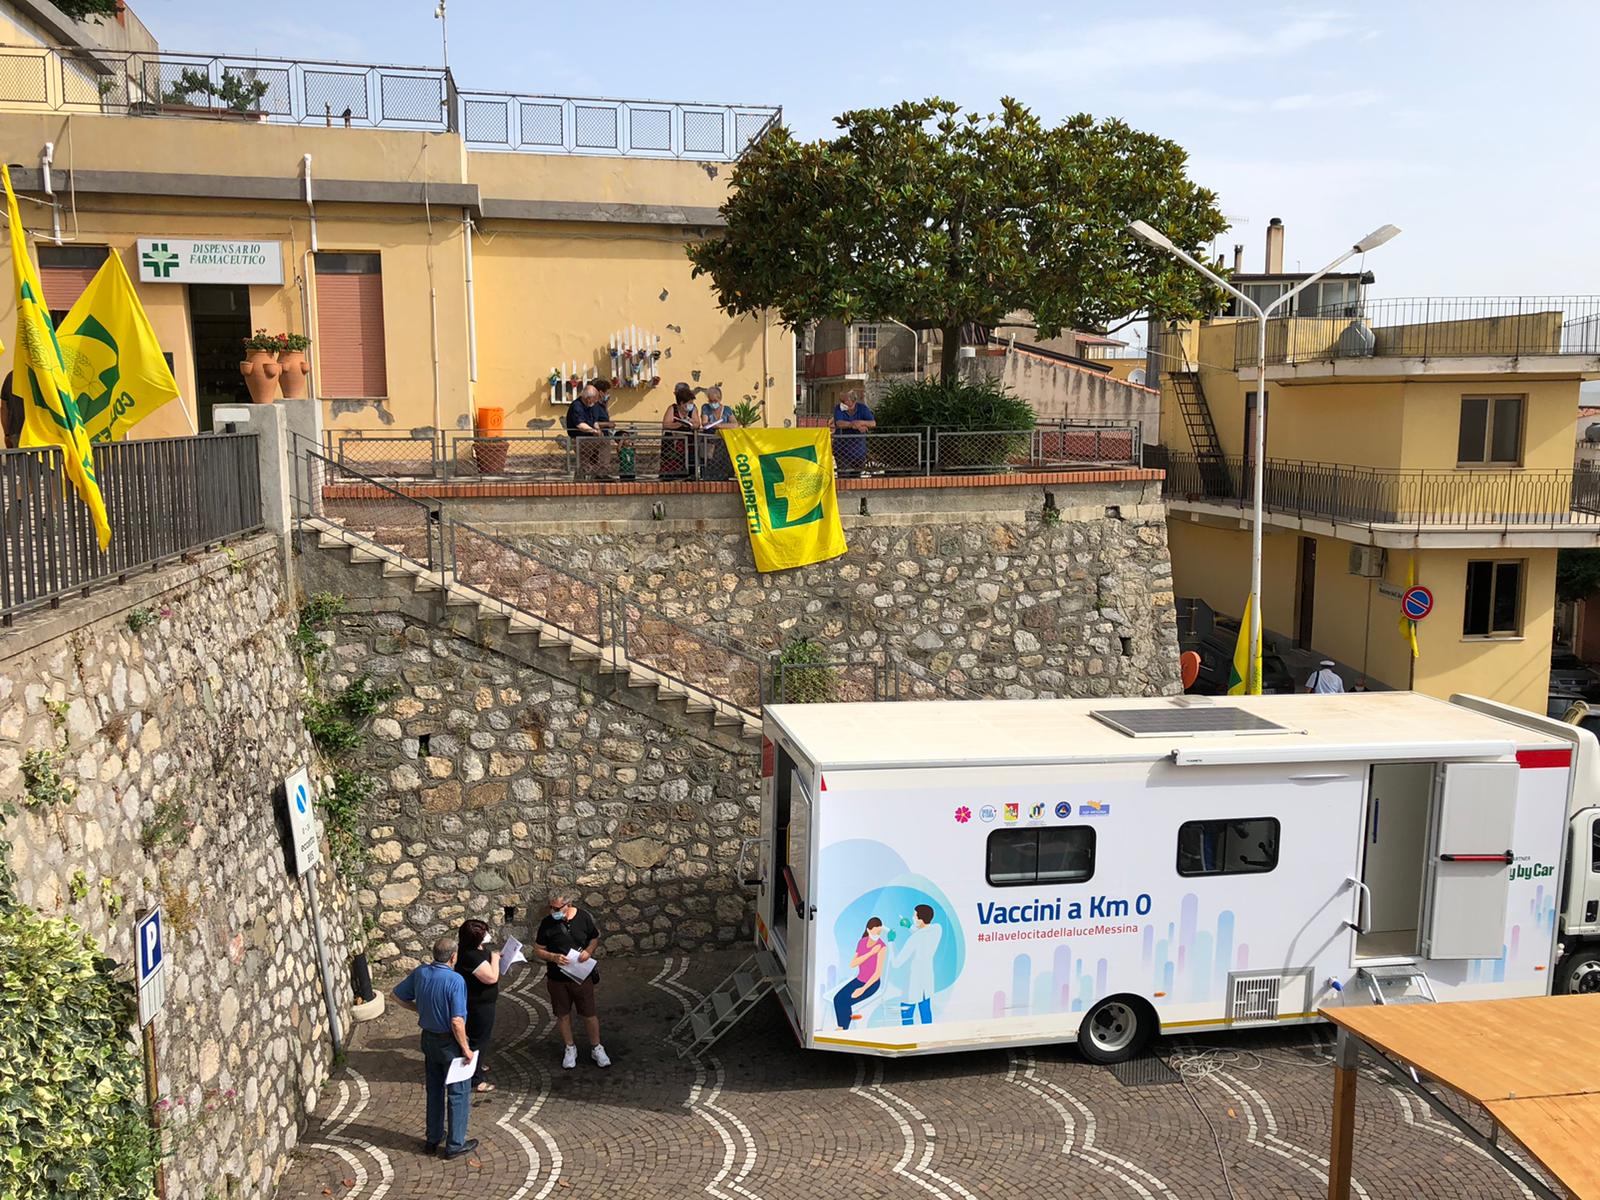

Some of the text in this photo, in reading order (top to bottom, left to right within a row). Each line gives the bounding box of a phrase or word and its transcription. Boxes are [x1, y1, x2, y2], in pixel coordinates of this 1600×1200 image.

[189, 254, 266, 265] FARMACEUTICO
[192, 243, 261, 254] DISPENSARIO
[736, 453, 761, 534] COLDIRETTI
[976, 893, 1152, 925] Vaccini a Km 0
[145, 919, 158, 971] P
[977, 923, 1139, 943] #allavelocitadellaluceMessina
